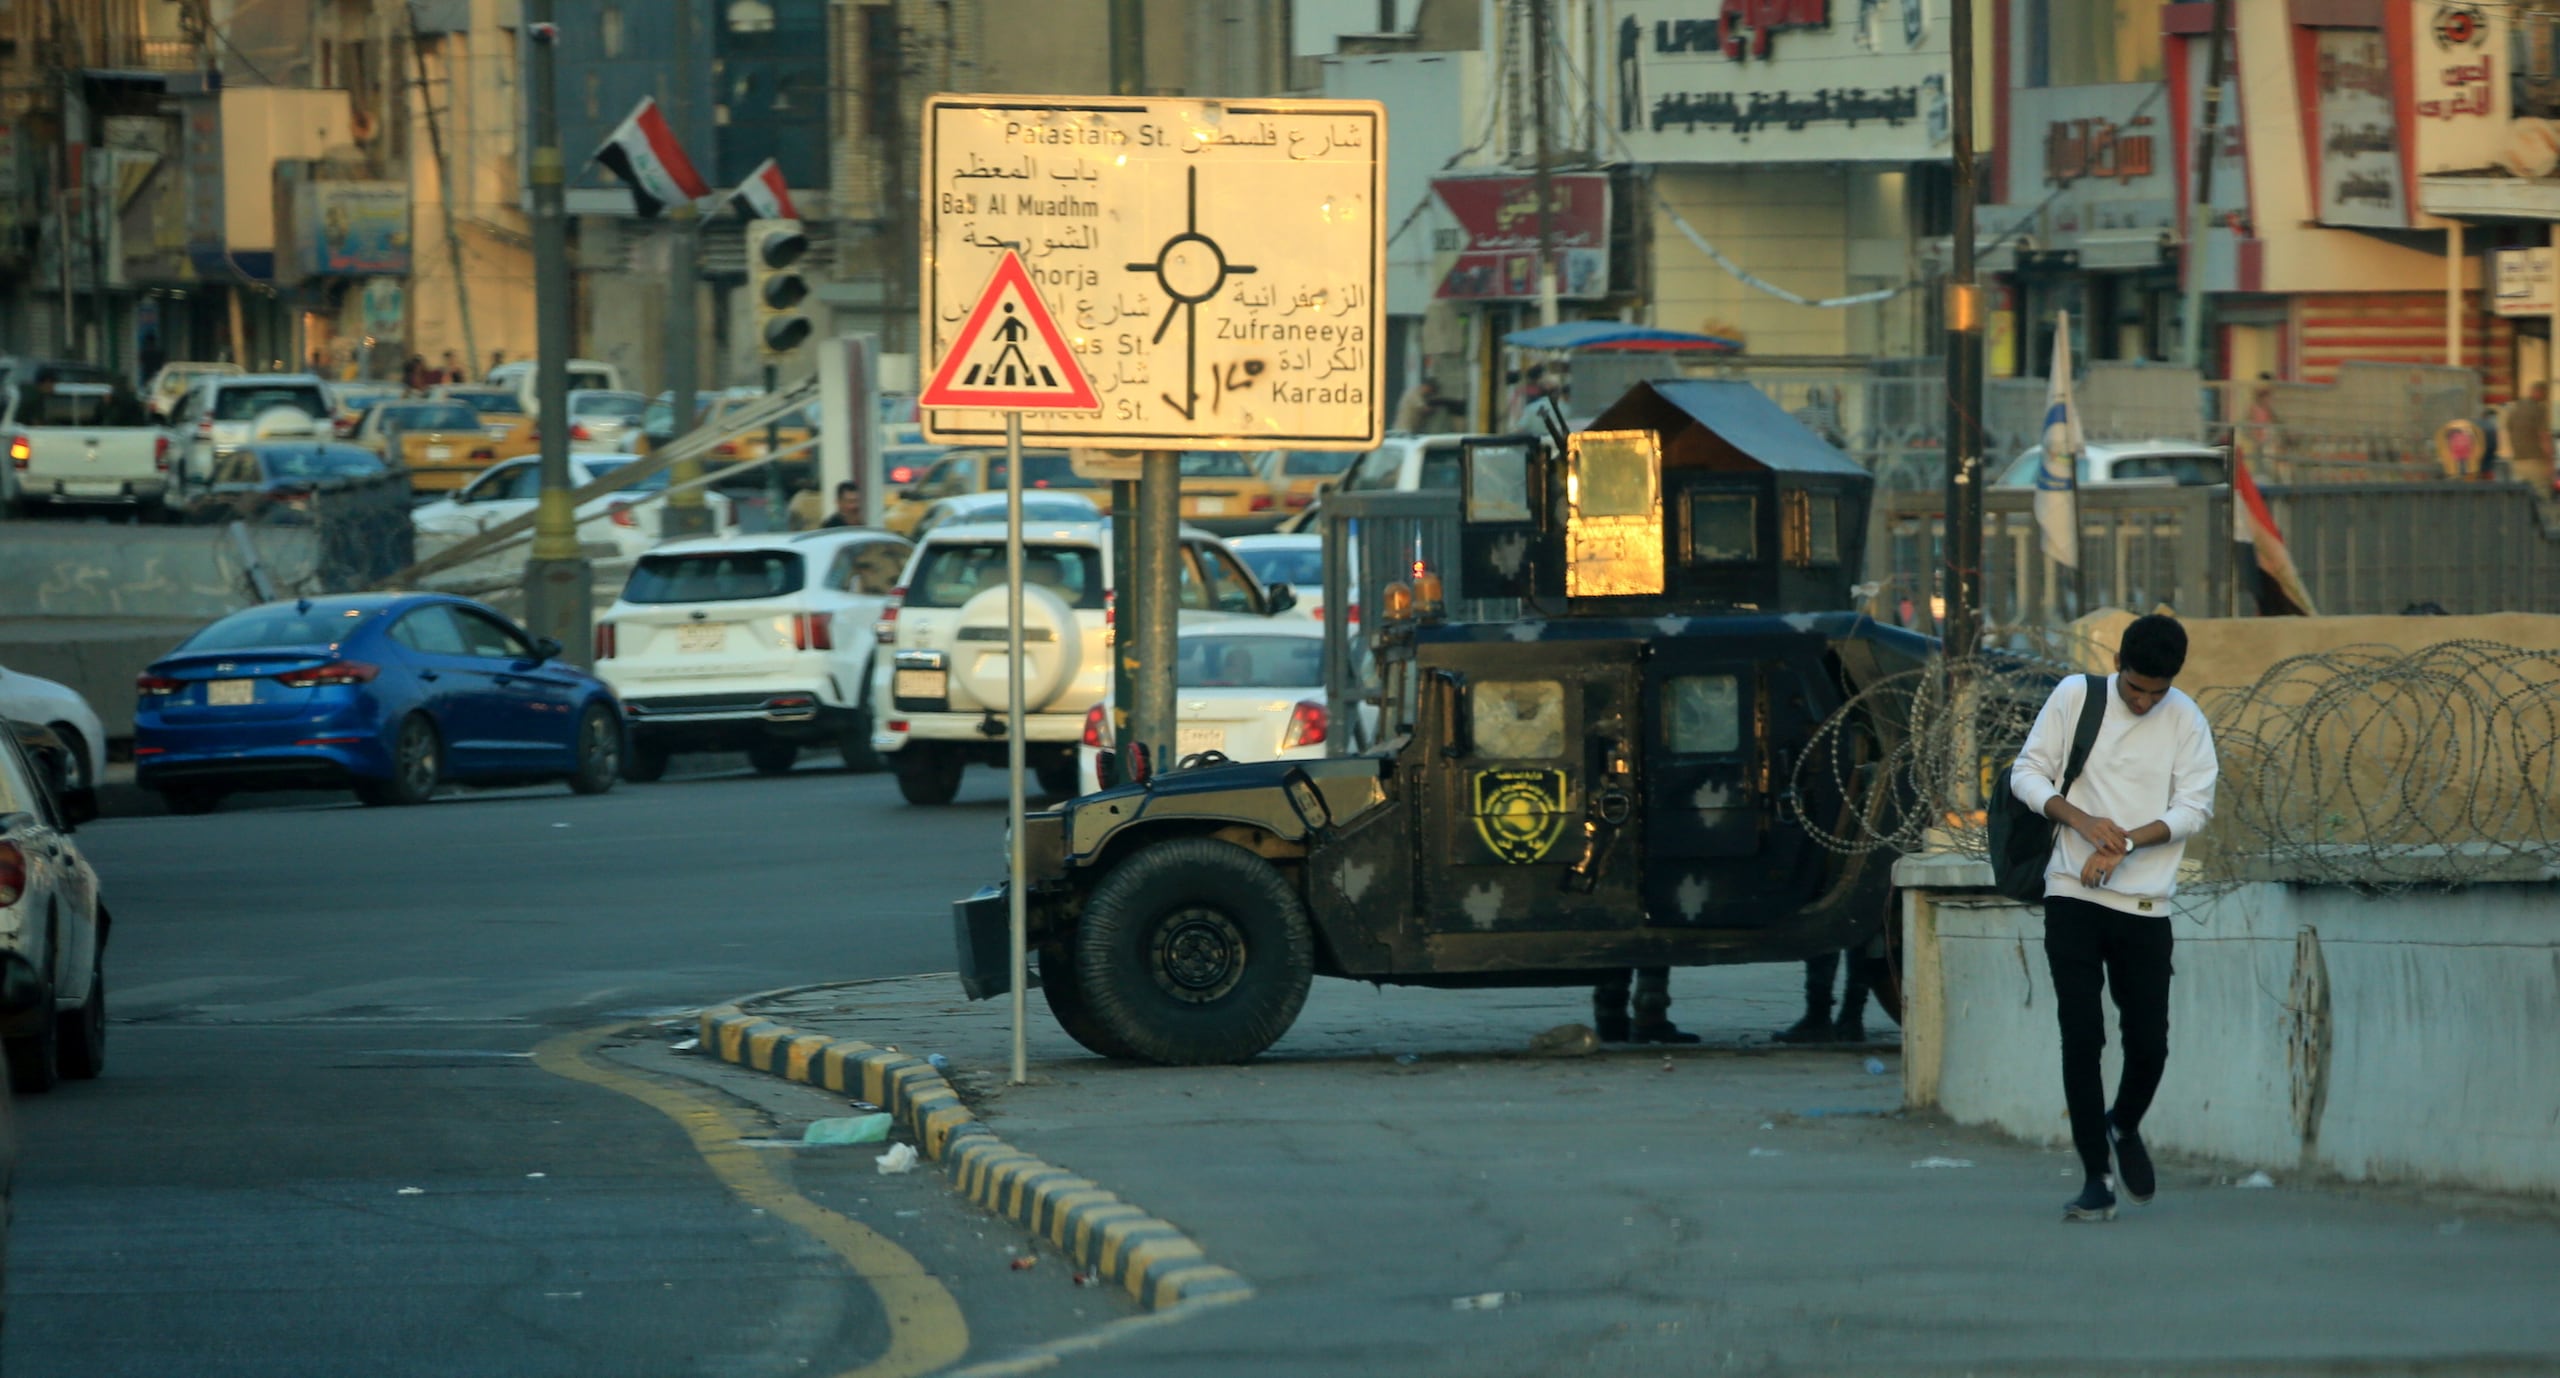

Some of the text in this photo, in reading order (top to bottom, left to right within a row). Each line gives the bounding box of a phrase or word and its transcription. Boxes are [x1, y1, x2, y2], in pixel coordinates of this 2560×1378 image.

[1138, 123, 1171, 147] St.
[1287, 123, 1362, 160] شارع
[952, 152, 1098, 190] باب المعظم
[987, 194, 1007, 215] Al
[1017, 195, 1099, 216] Muadhm
[962, 221, 1098, 257] الشورجة
[1033, 265, 1098, 291] horja
[1076, 292, 1149, 330] شارع
[1117, 333, 1149, 356] St.
[1216, 315, 1364, 347] Zufraneeya
[1087, 360, 1149, 393] شار
[1279, 346, 1365, 380] الكرادة
[1271, 381, 1364, 404] Karada
[1117, 398, 1149, 421] St.
